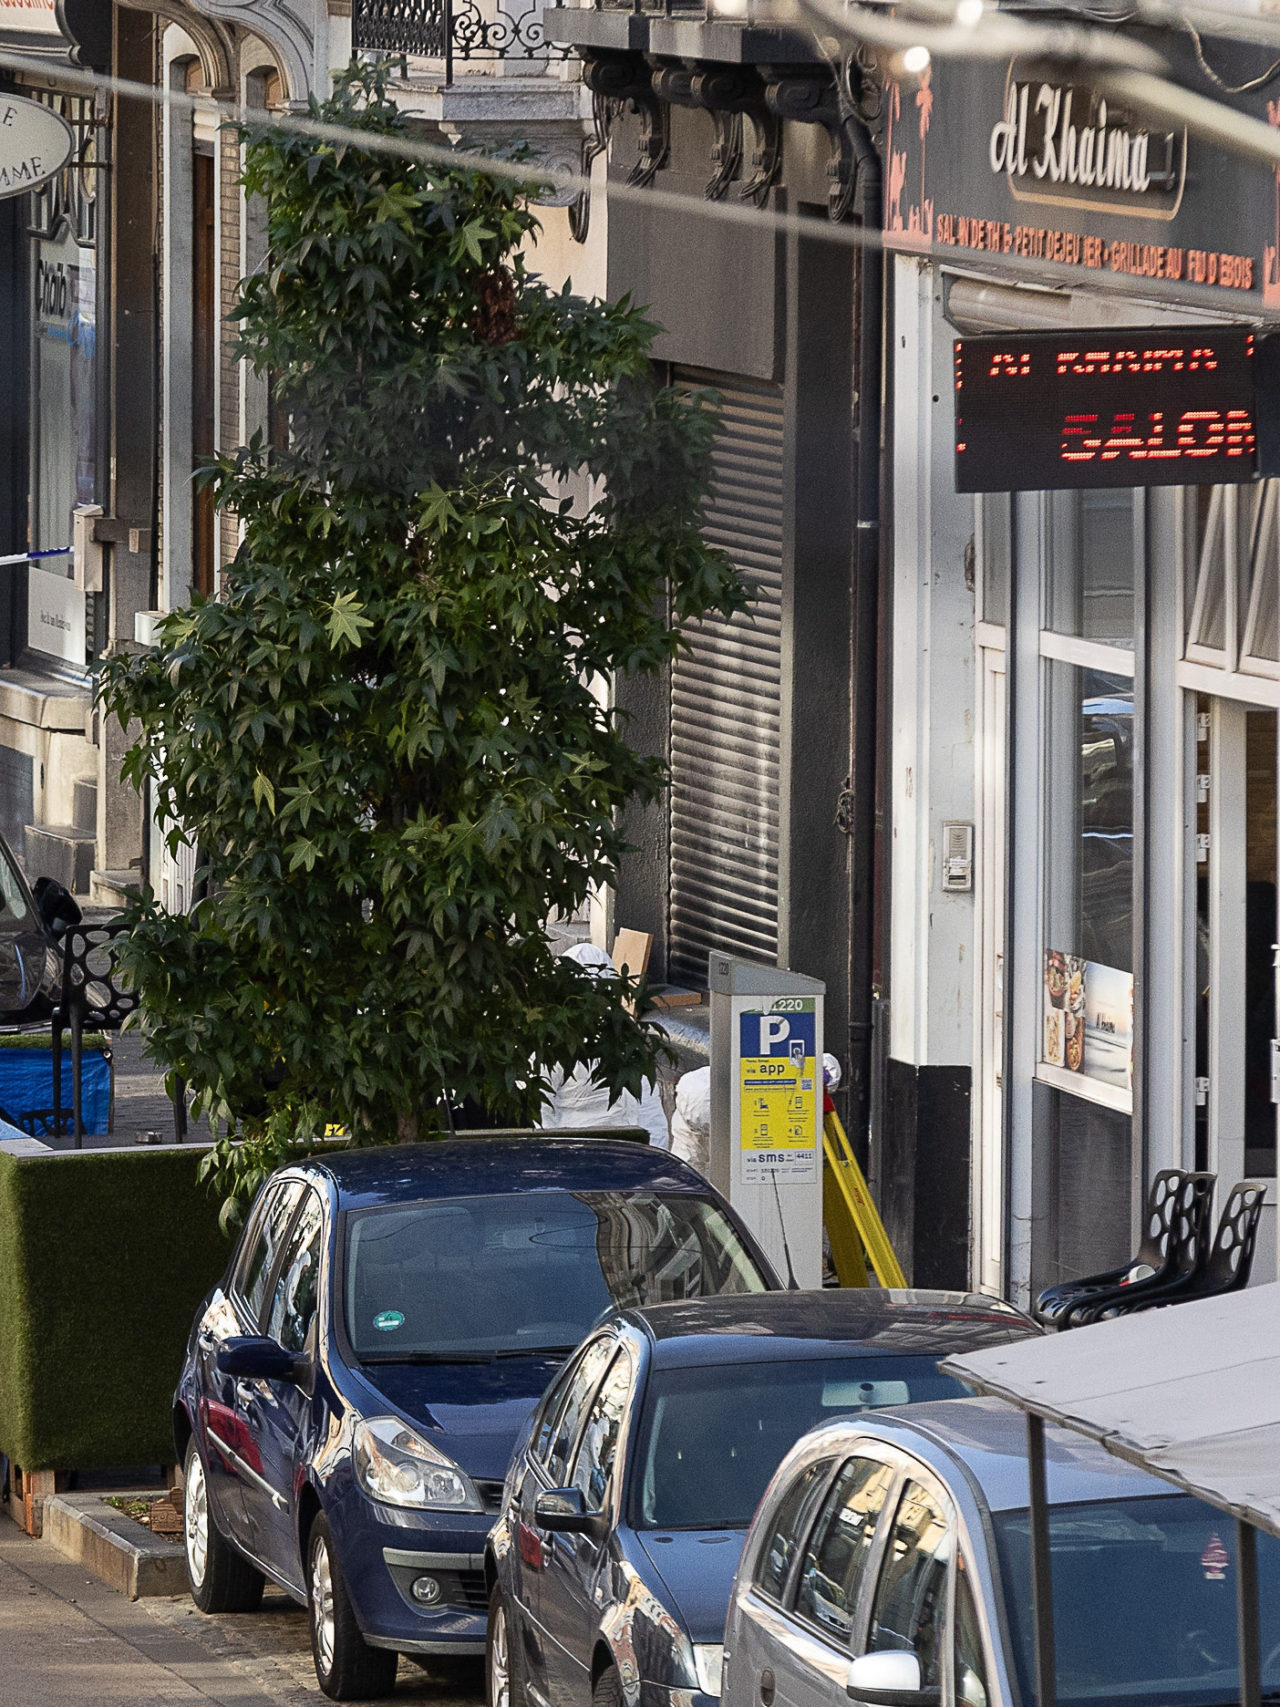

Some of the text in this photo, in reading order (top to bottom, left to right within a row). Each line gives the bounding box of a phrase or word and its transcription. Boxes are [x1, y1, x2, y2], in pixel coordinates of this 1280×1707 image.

[760, 1015, 791, 1055] P
[760, 1065, 785, 1076] app
[758, 1153, 785, 1163] sms
